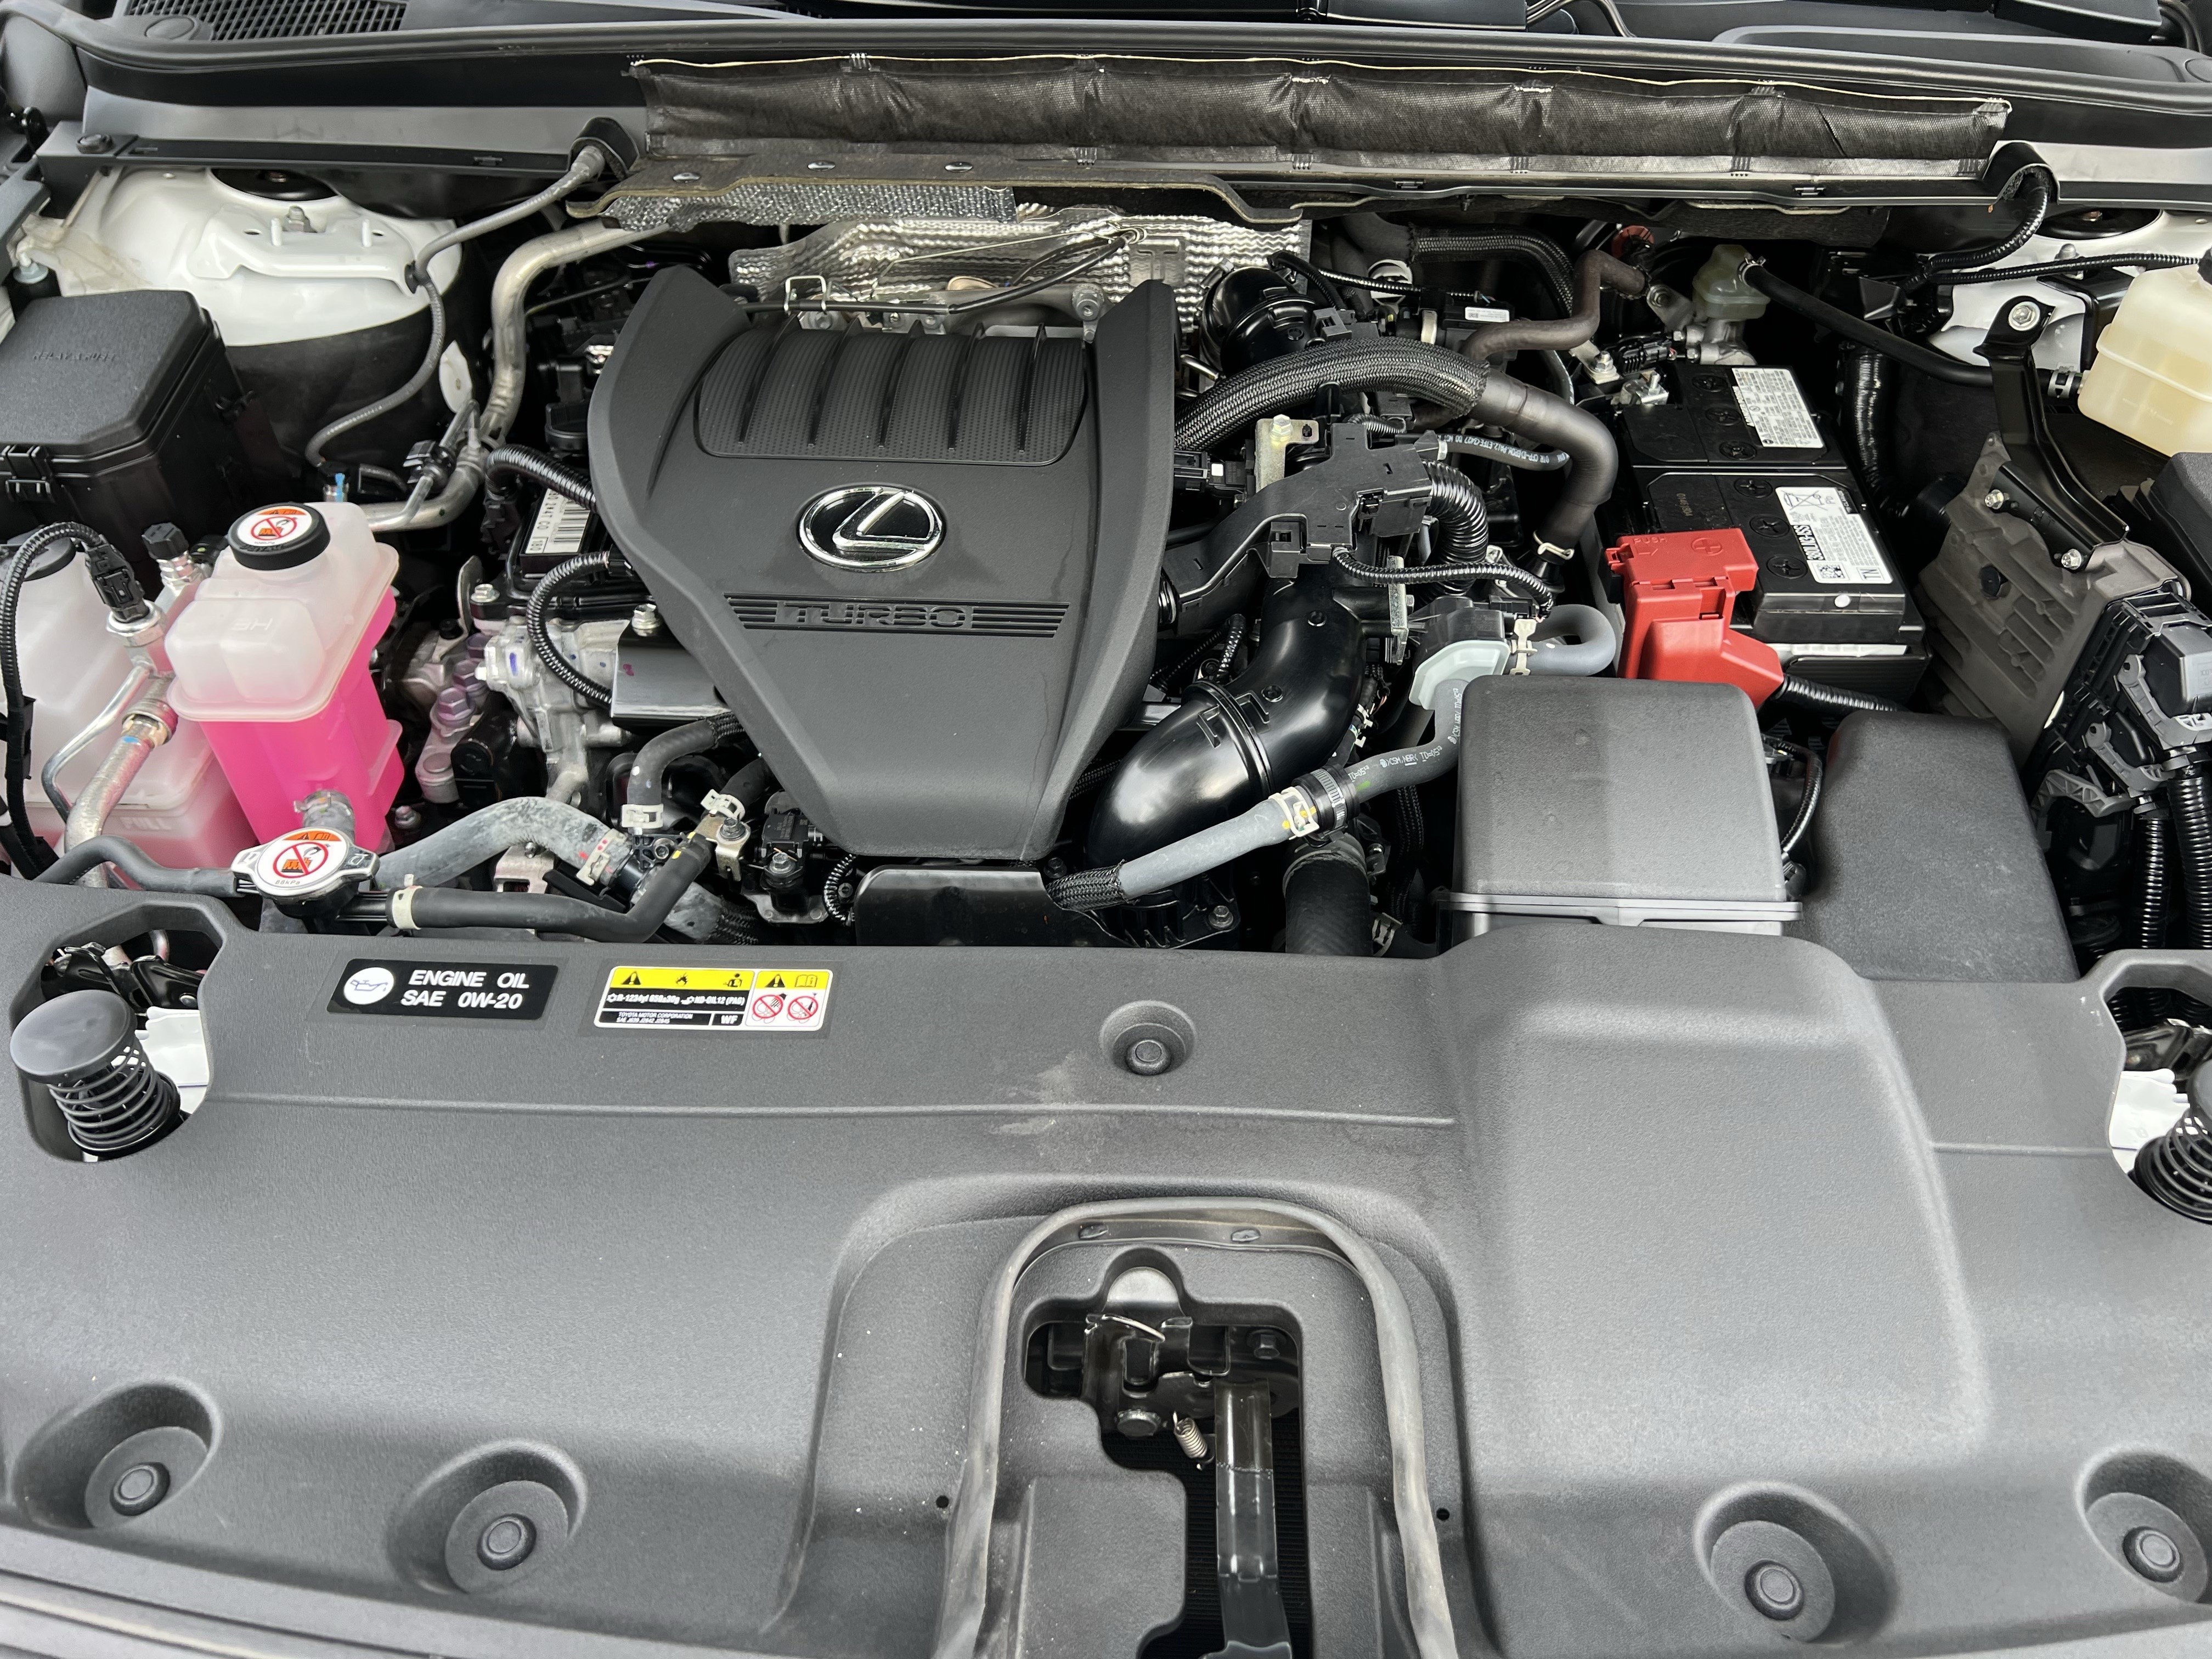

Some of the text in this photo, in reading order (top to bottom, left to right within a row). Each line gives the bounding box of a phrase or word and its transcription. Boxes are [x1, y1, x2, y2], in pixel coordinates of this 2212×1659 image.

[783, 602, 966, 627] TURBO
[408, 969, 529, 989] ENGINE OIL
[400, 990, 523, 1009] SAE 0W-20
[721, 1015, 738, 1024] WF
